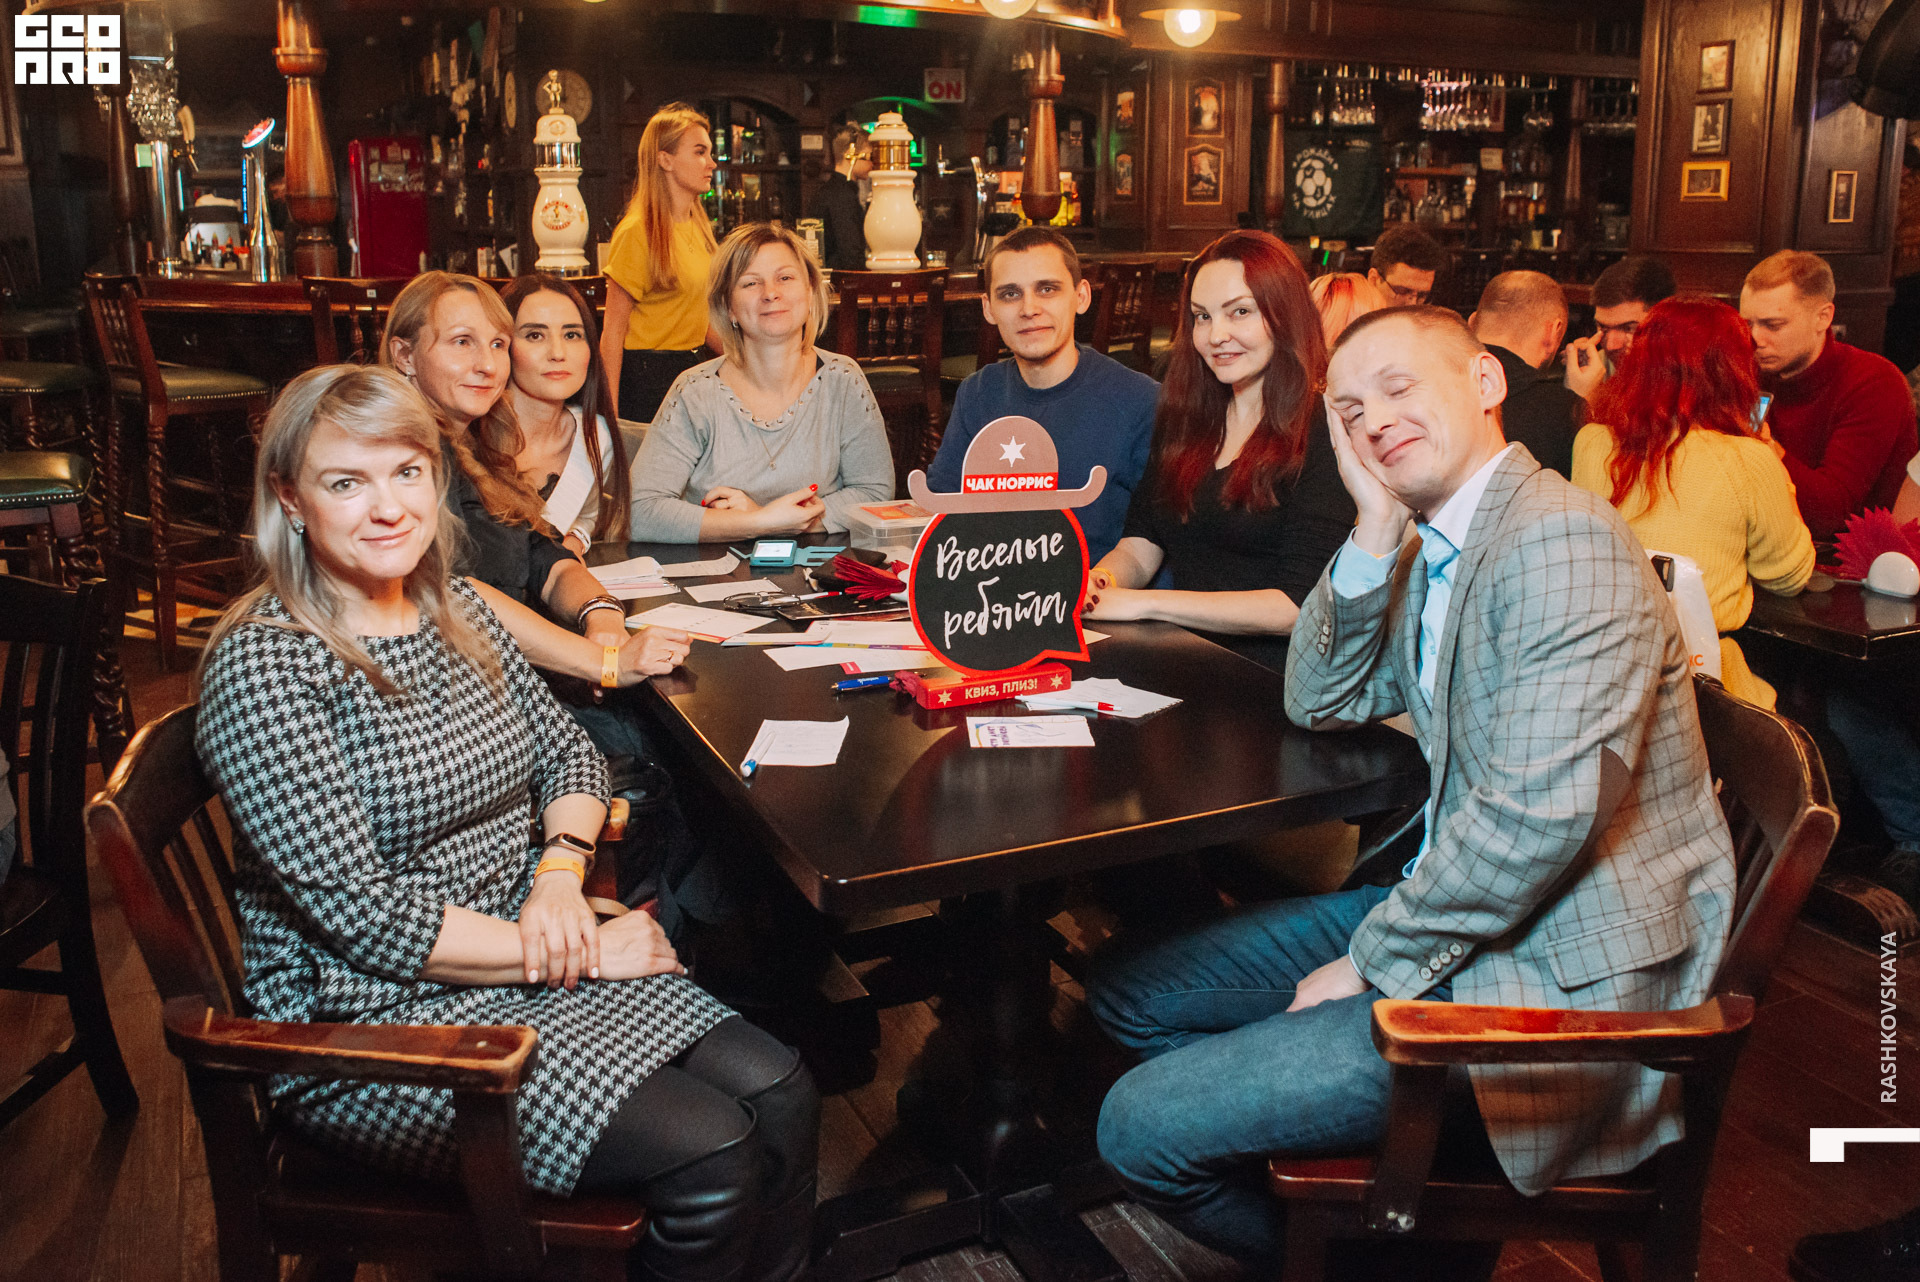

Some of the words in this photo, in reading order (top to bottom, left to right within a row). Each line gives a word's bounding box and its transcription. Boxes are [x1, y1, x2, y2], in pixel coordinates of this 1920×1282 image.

[928, 81, 962, 99] ON
[966, 478, 995, 491] ЧАК
[997, 475, 1055, 490] НОРРИС
[936, 532, 1064, 581] Веселые
[944, 576, 1067, 649] ребята
[965, 684, 1000, 699] КВИЗ,
[1002, 678, 1038, 694] ПЛИЗ!
